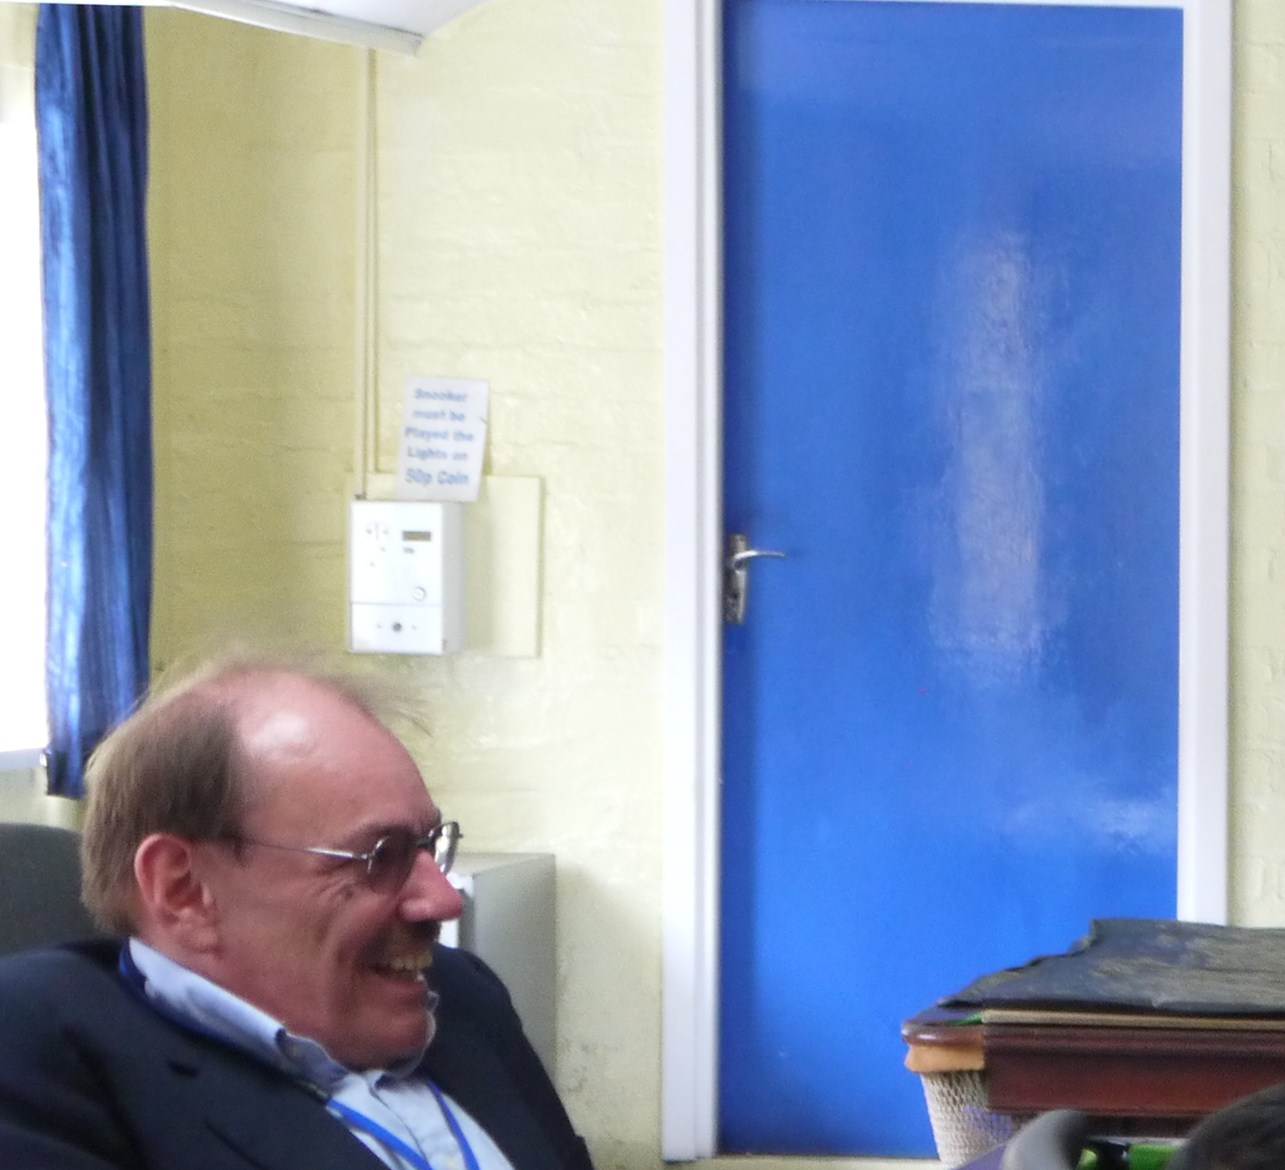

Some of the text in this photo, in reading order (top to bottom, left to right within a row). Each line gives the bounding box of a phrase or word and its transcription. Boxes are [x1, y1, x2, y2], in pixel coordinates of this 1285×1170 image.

[449, 409, 465, 422] be
[405, 426, 474, 443] Played the
[407, 446, 468, 461] Lights on
[438, 470, 469, 485] Coin
